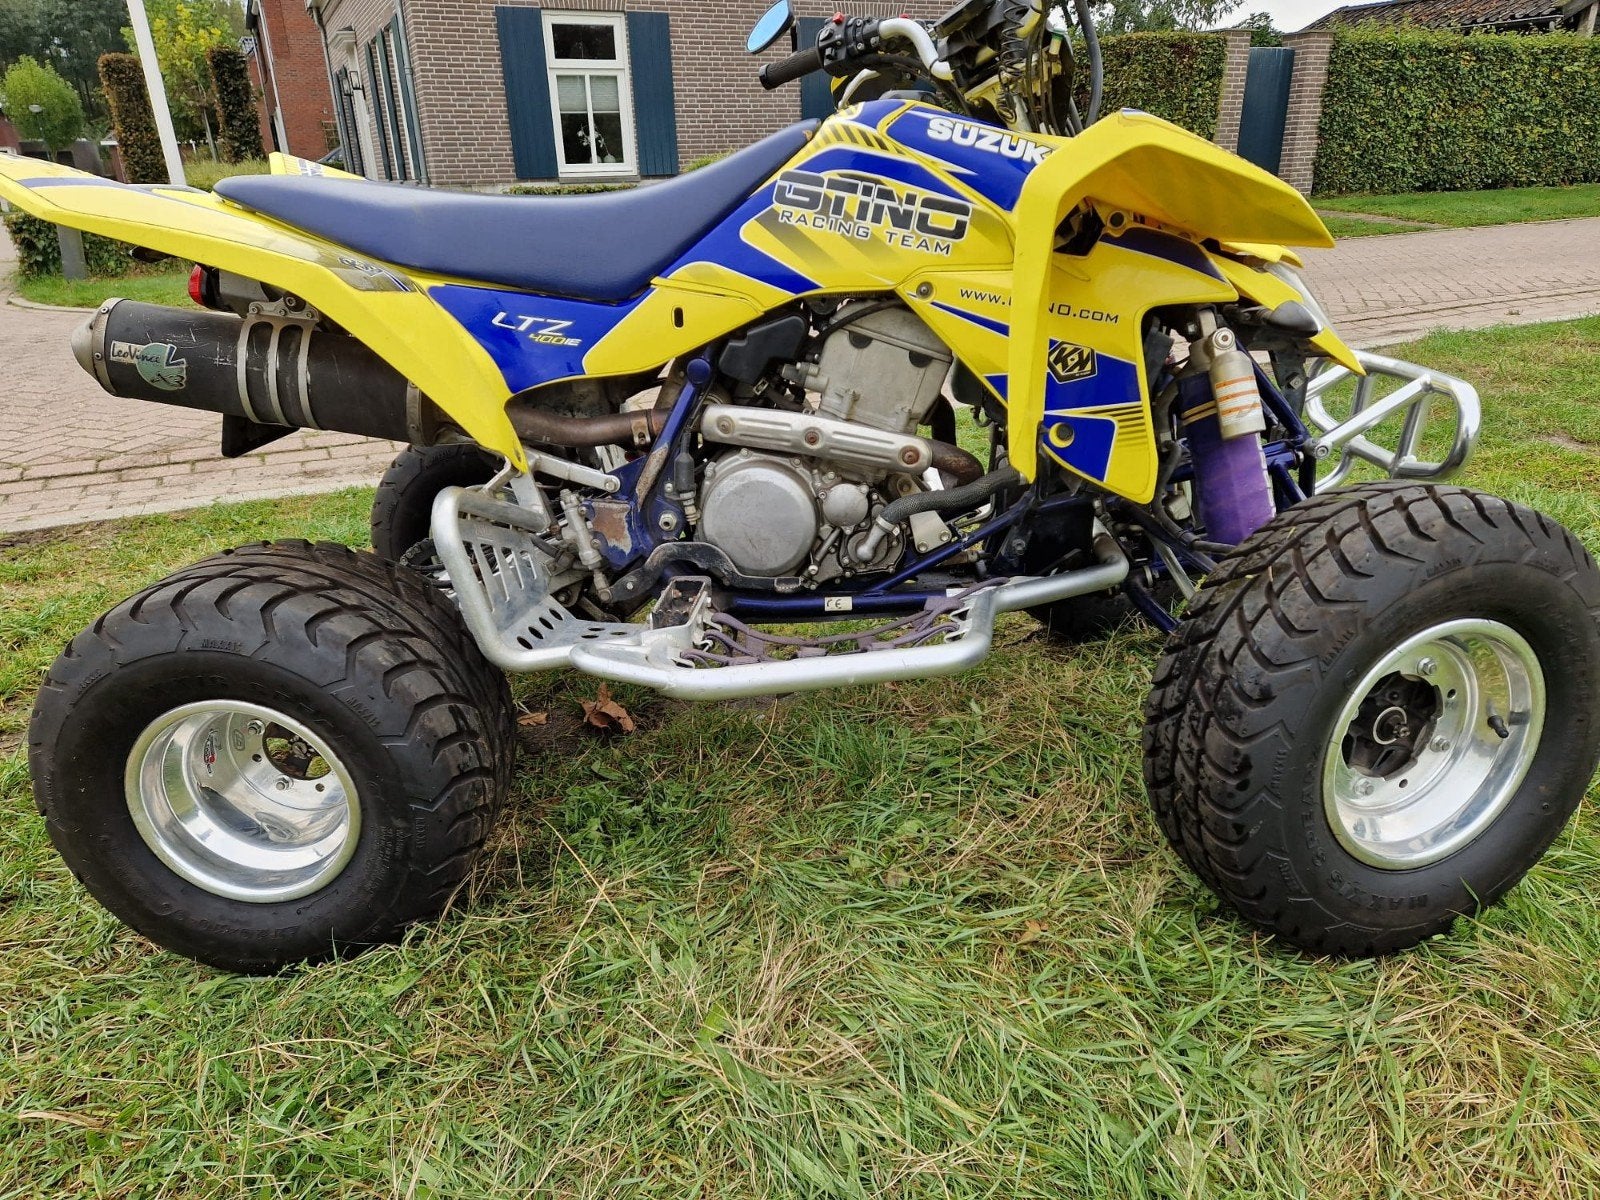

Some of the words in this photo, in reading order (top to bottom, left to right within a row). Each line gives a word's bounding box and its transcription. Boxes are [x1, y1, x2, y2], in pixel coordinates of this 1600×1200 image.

[927, 117, 1053, 165] SUZUK
[779, 209, 870, 240] RACING
[886, 230, 951, 256] TEAM
[491, 311, 574, 336] LTZ
